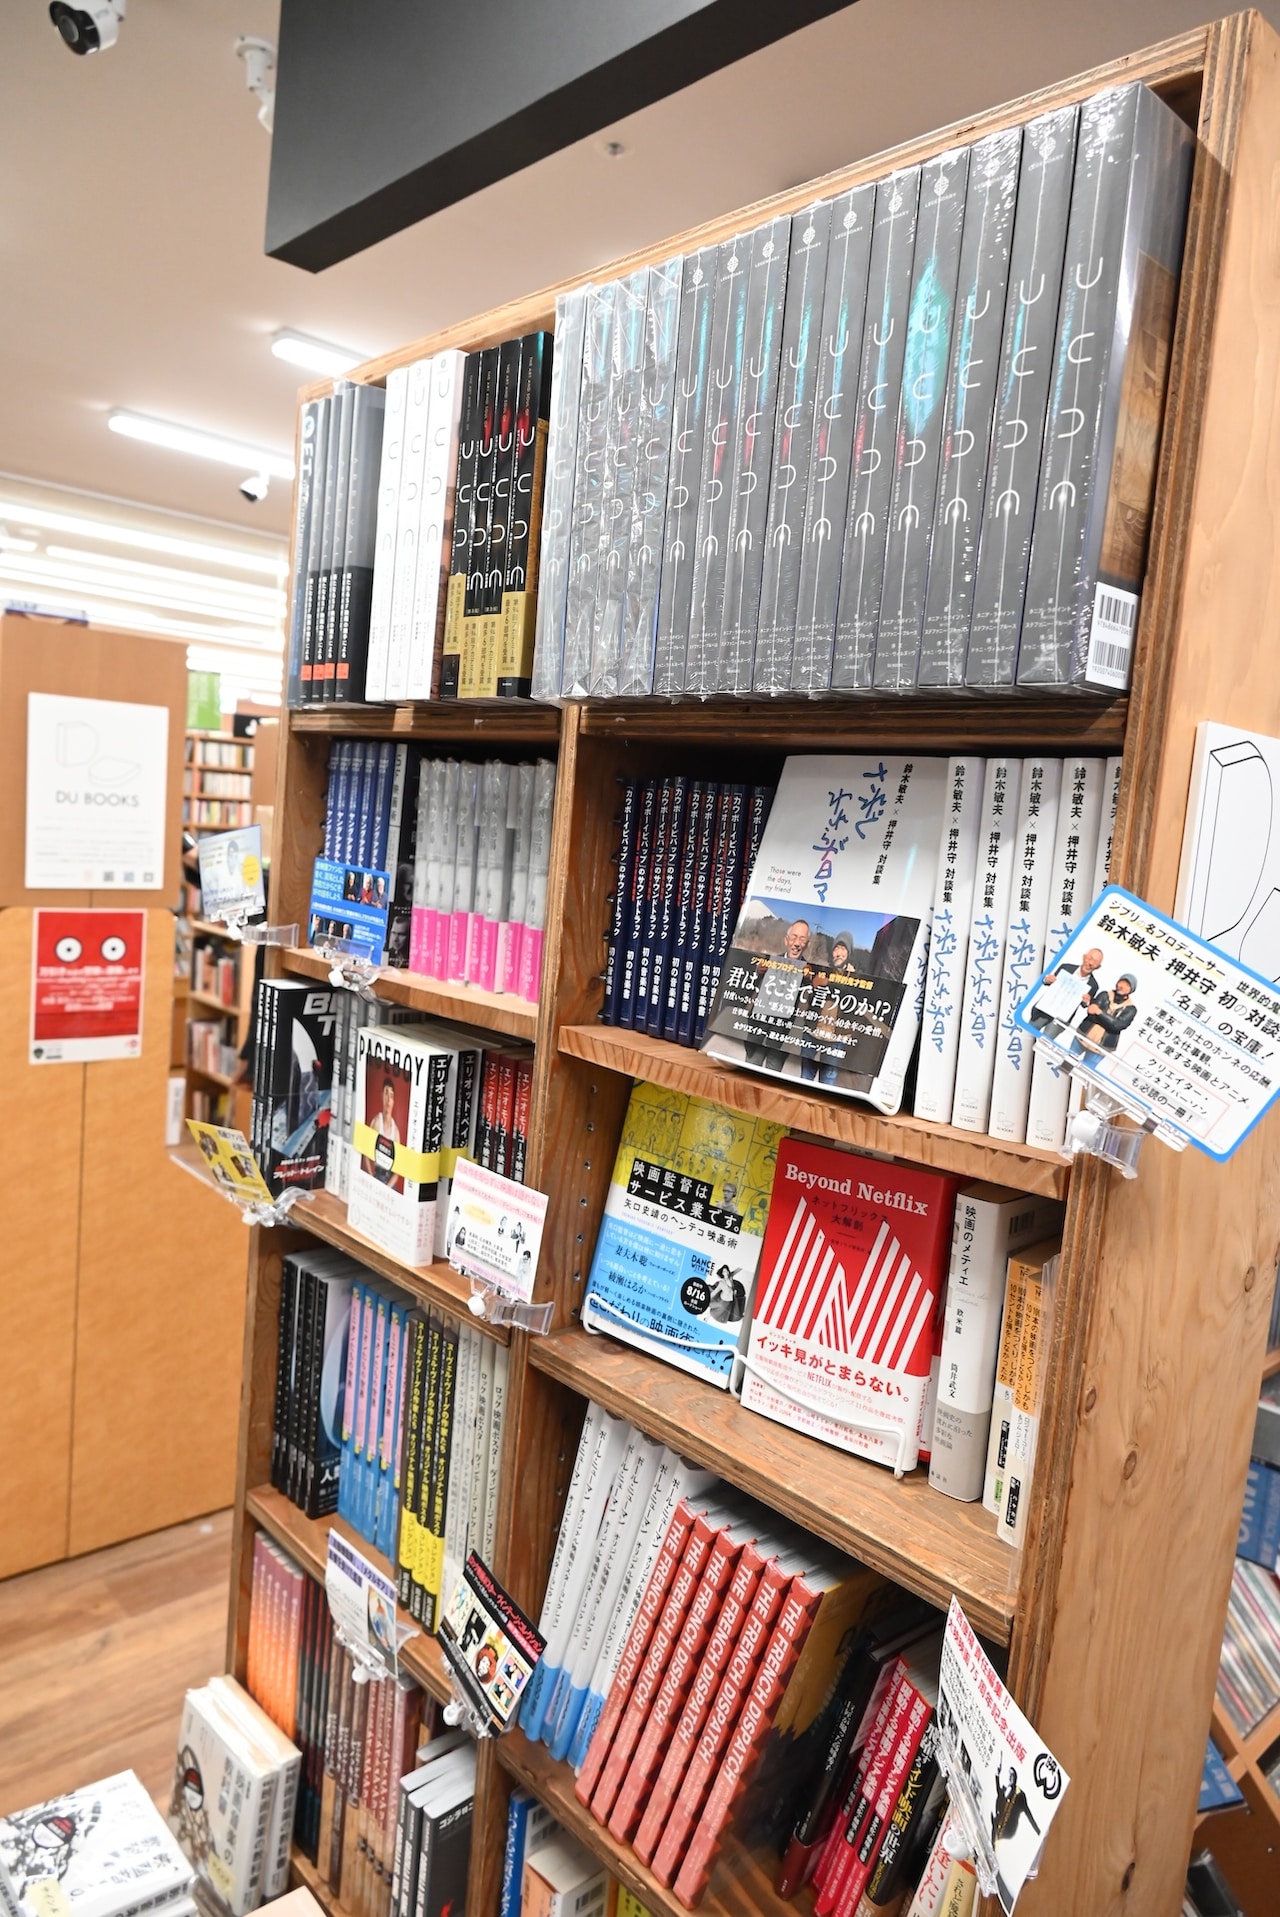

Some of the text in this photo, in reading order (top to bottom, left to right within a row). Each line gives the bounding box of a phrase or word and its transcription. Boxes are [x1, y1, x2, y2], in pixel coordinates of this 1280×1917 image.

[55, 790, 140, 808] DU BOOKS
[894, 763, 914, 805] 鈴木敏夫
[951, 765, 966, 814] 鈴木敏夫
[1069, 767, 1087, 820] 鈴木敏夫
[882, 819, 898, 851] 押井守
[945, 828, 960, 865] 押井守
[982, 766, 1008, 910] 鈴木敏夫 押井守 対談集
[1017, 766, 1044, 913] 鈴木敏夫 押井守 対談集
[1063, 834, 1080, 875] 押井守
[769, 866, 802, 877] Those were
[774, 884, 791, 895] friend
[871, 853, 888, 886] 対談集
[941, 867, 956, 904] 対談集
[1060, 877, 1076, 917] 対談集
[1096, 914, 1162, 962] 鈴木敏夫
[1164, 957, 1218, 997] 押井守
[1107, 899, 1226, 978] ジブリの名プロデューサー
[632, 1159, 709, 1200] 映画監督は
[785, 1163, 929, 1217] Beyond Netflix
[622, 1198, 739, 1250] 矢口史靖のヘンテコ映画術
[628, 1178, 741, 1235] サービス業です。
[811, 1195, 888, 1222] ネットフリックス
[691, 1254, 716, 1270] DANCE
[958, 1204, 977, 1287] 映画のメティエ
[608, 1270, 647, 1295] 綾瀬はるか
[686, 1285, 706, 1302] 8/16
[756, 1335, 910, 1403] イッキ見がとまらない。
[807, 1371, 832, 1388] NETFLIX
[935, 1427, 953, 1440] 多彩な
[936, 1407, 962, 1424] 映画史の
[571, 1415, 593, 1487] ポール・ニューマン
[583, 1429, 607, 1500] ポール・ニューマン
[609, 1443, 635, 1513] ポール・ニューマン
[618, 1455, 645, 1526] ポール・ニューマン
[640, 1462, 669, 1534] ポール・ニューマン
[652, 1477, 681, 1548] ポール・ニューマン
[615, 1518, 685, 1692] THE FRENCH DISPATCH
[634, 1535, 705, 1710] THE FRENCH DISPATCH
[653, 1549, 727, 1727] THE FRENCH DISPATCH
[677, 1563, 753, 1745] THE FRENCH DISPATCH
[698, 1580, 777, 1764] THE FRENCH DISPATCH
[722, 1597, 804, 1785] THE FRENCH DISPATCH
[978, 1681, 1028, 1765] 周年記念出版
